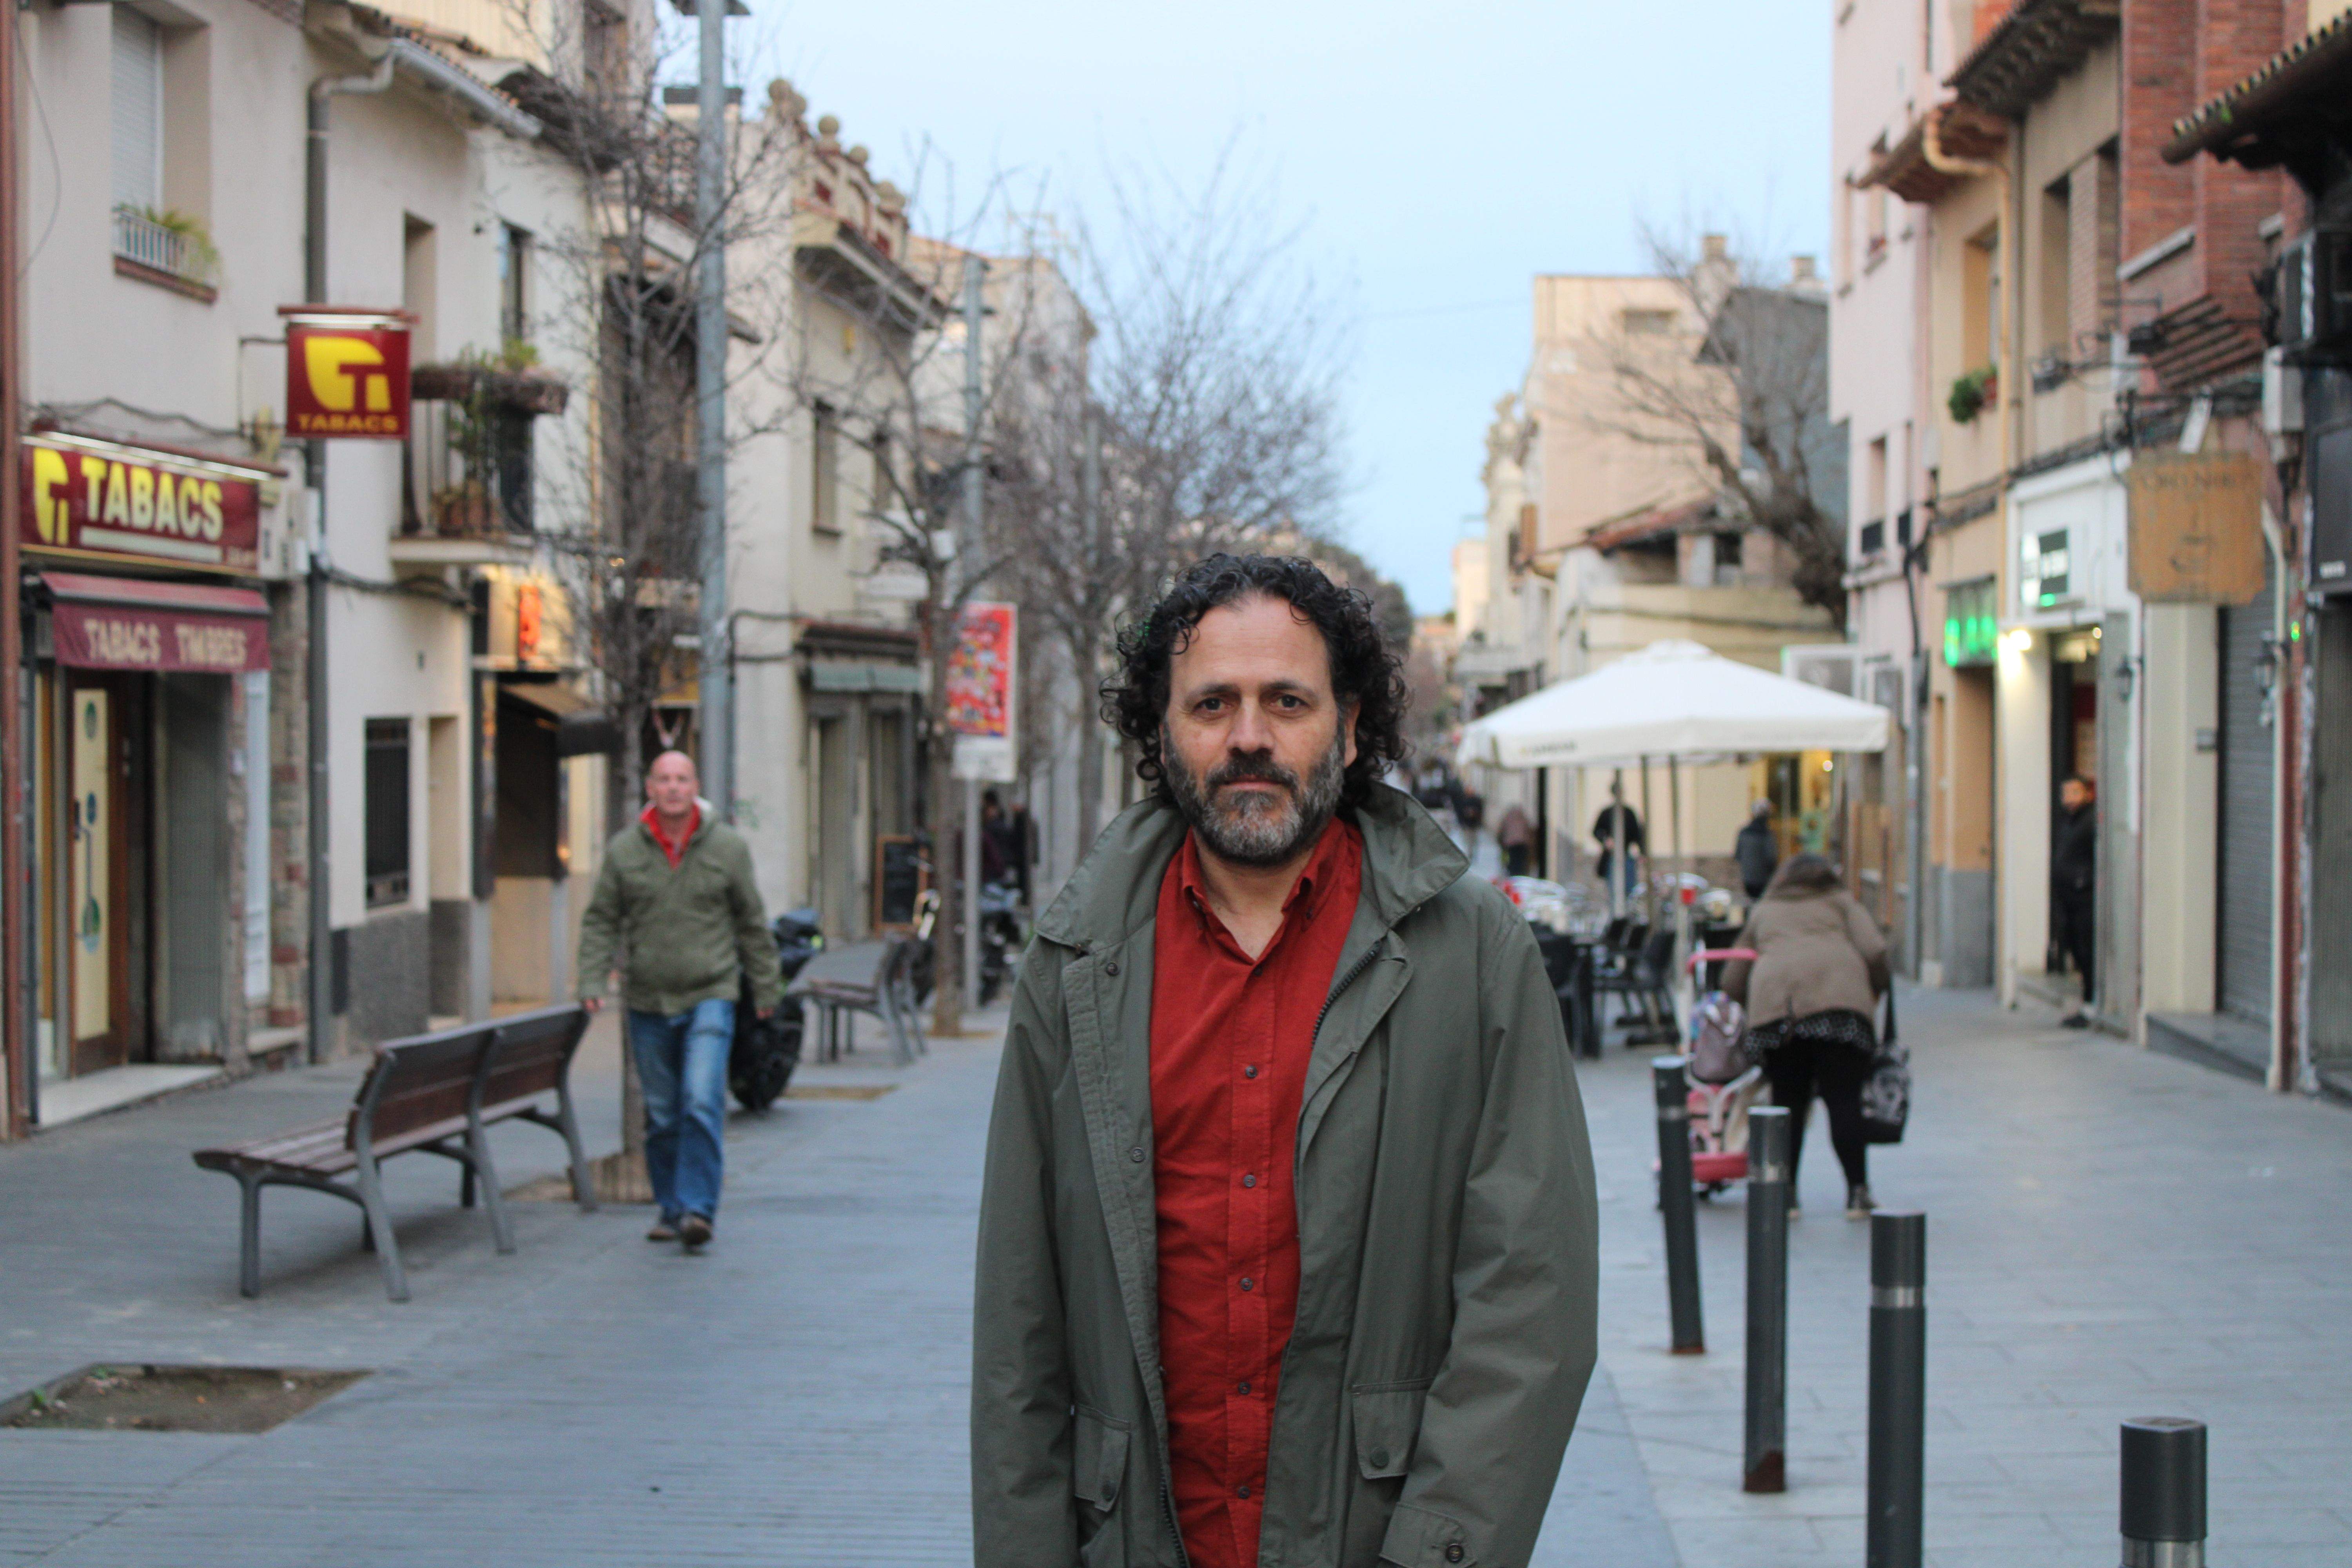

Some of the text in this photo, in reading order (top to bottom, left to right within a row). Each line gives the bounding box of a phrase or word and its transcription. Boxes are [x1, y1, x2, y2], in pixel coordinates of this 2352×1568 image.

[298, 414, 398, 431] TABACS
[81, 455, 223, 542] TABACS
[83, 618, 162, 664] TABACS
